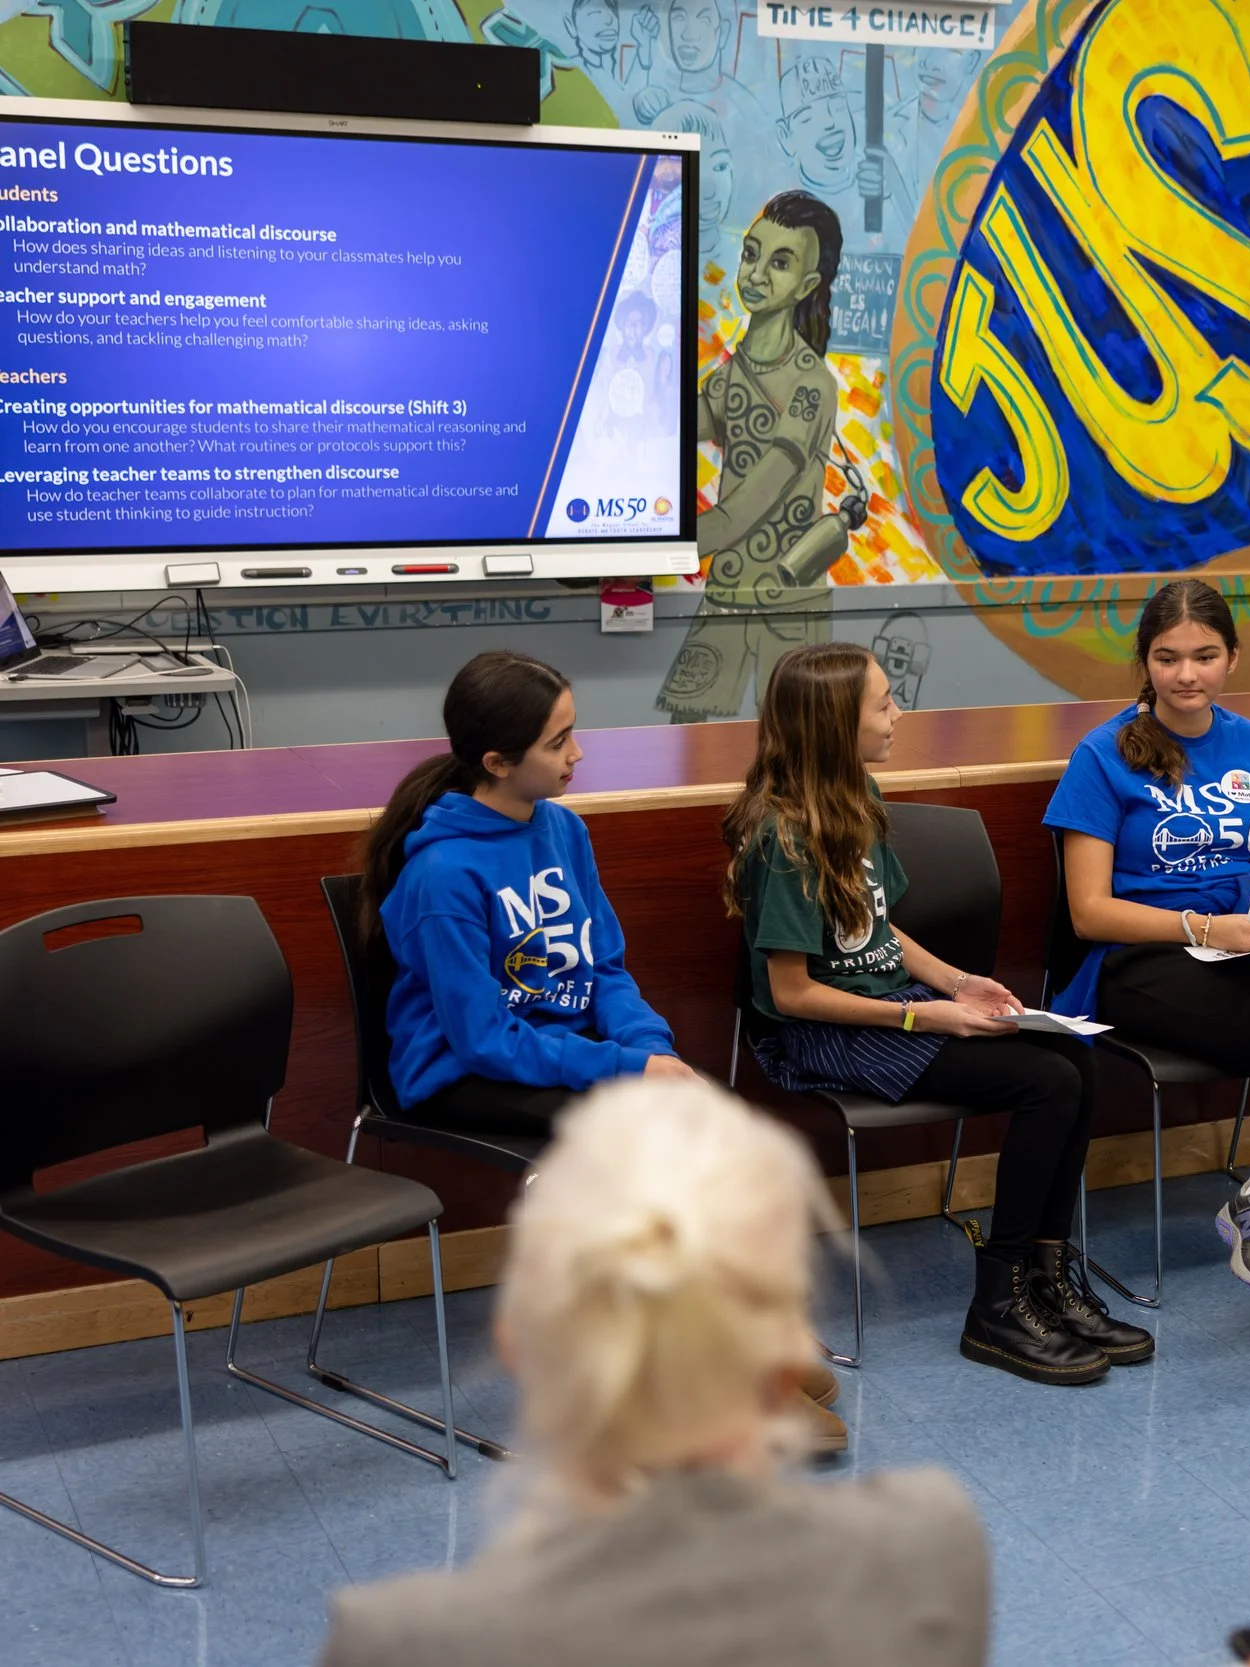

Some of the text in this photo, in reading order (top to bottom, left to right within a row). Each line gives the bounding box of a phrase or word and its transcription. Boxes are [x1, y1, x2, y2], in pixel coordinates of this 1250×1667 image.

[840, 6, 861, 31] 4
[868, 8, 989, 43] CHANGE!
[74, 143, 233, 177] Questions
[105, 220, 137, 236] and
[141, 221, 255, 240] mathematical
[259, 225, 336, 243] discourse
[13, 239, 461, 268] How does sharing ideas and listening to your classmates help you
[13, 260, 146, 276] understand math?
[57, 291, 125, 308] support
[129, 290, 160, 306] and
[163, 294, 266, 310] engagement
[850, 294, 866, 310] ES
[17, 310, 488, 335] How do your teachers help you feel comfortable sharing ideas, asking
[17, 331, 307, 350] questions, and tackling challenging math?
[0, 368, 67, 384] eachers
[69, 399, 185, 417] opportunities
[188, 399, 213, 415] for
[216, 400, 326, 415] mathematical
[330, 400, 404, 415] discourse
[407, 400, 448, 417] (Shift
[452, 400, 466, 417] 3)
[23, 420, 526, 437] How do you encourage students to share their mathematical reasoning and
[23, 439, 466, 457] learn from one another? What routines or protocols support this?
[91, 467, 157, 482] teacher
[159, 468, 210, 482] teams
[213, 467, 231, 481] to
[234, 465, 322, 484] strengthen
[325, 465, 399, 480] discourse
[26, 484, 518, 503] How do teacher teams collaborate to plan for mathematical discourse and
[27, 504, 313, 523] use student thinking to guide instruction?
[95, 603, 309, 634] UESTION
[1144, 781, 1235, 816] MS
[498, 867, 571, 939] MS
